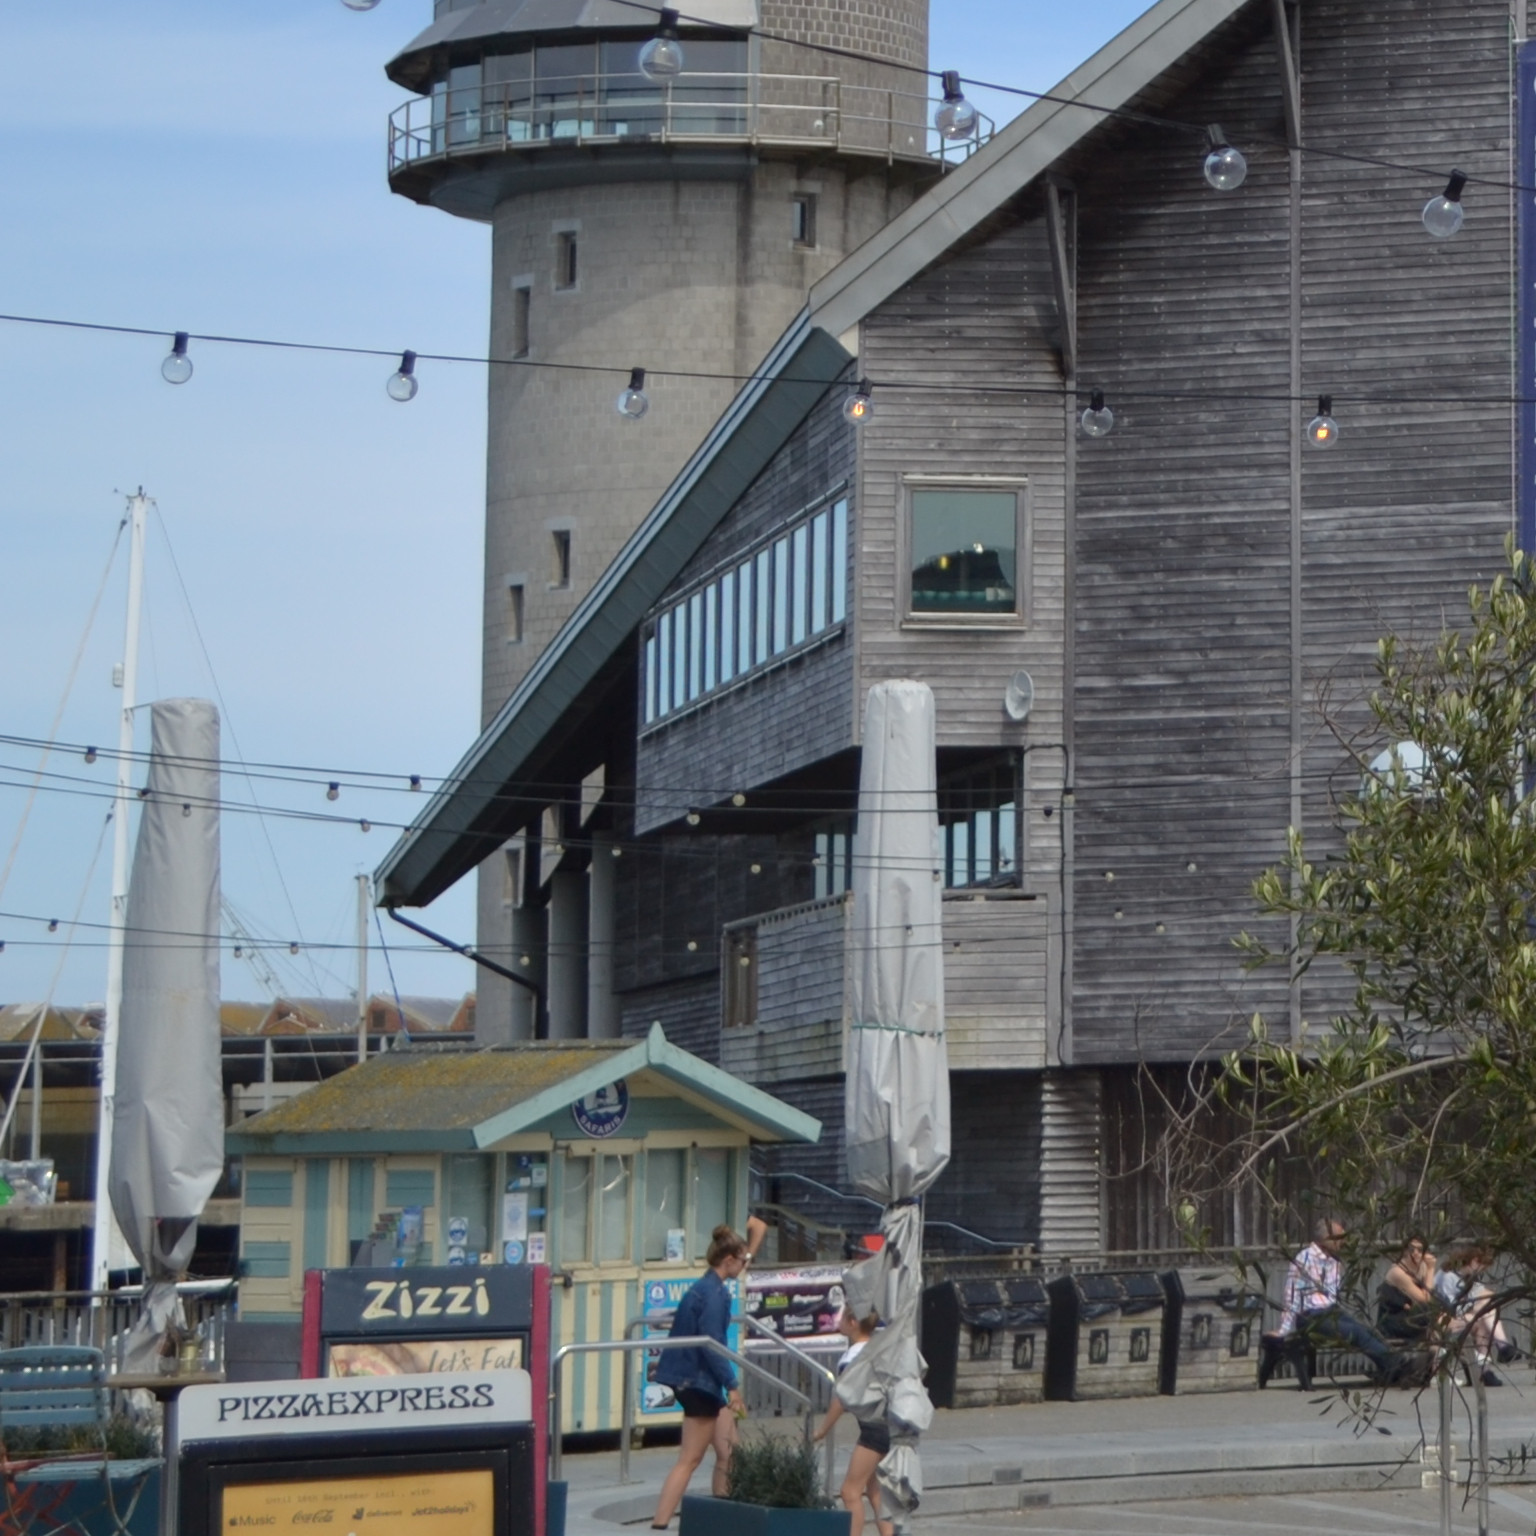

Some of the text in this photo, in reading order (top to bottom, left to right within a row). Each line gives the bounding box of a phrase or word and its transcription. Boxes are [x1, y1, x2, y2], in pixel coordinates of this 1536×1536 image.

[579, 1115, 621, 1135] SAFARIS
[361, 1278, 490, 1320] Zizzi
[239, 1513, 276, 1527] Music
